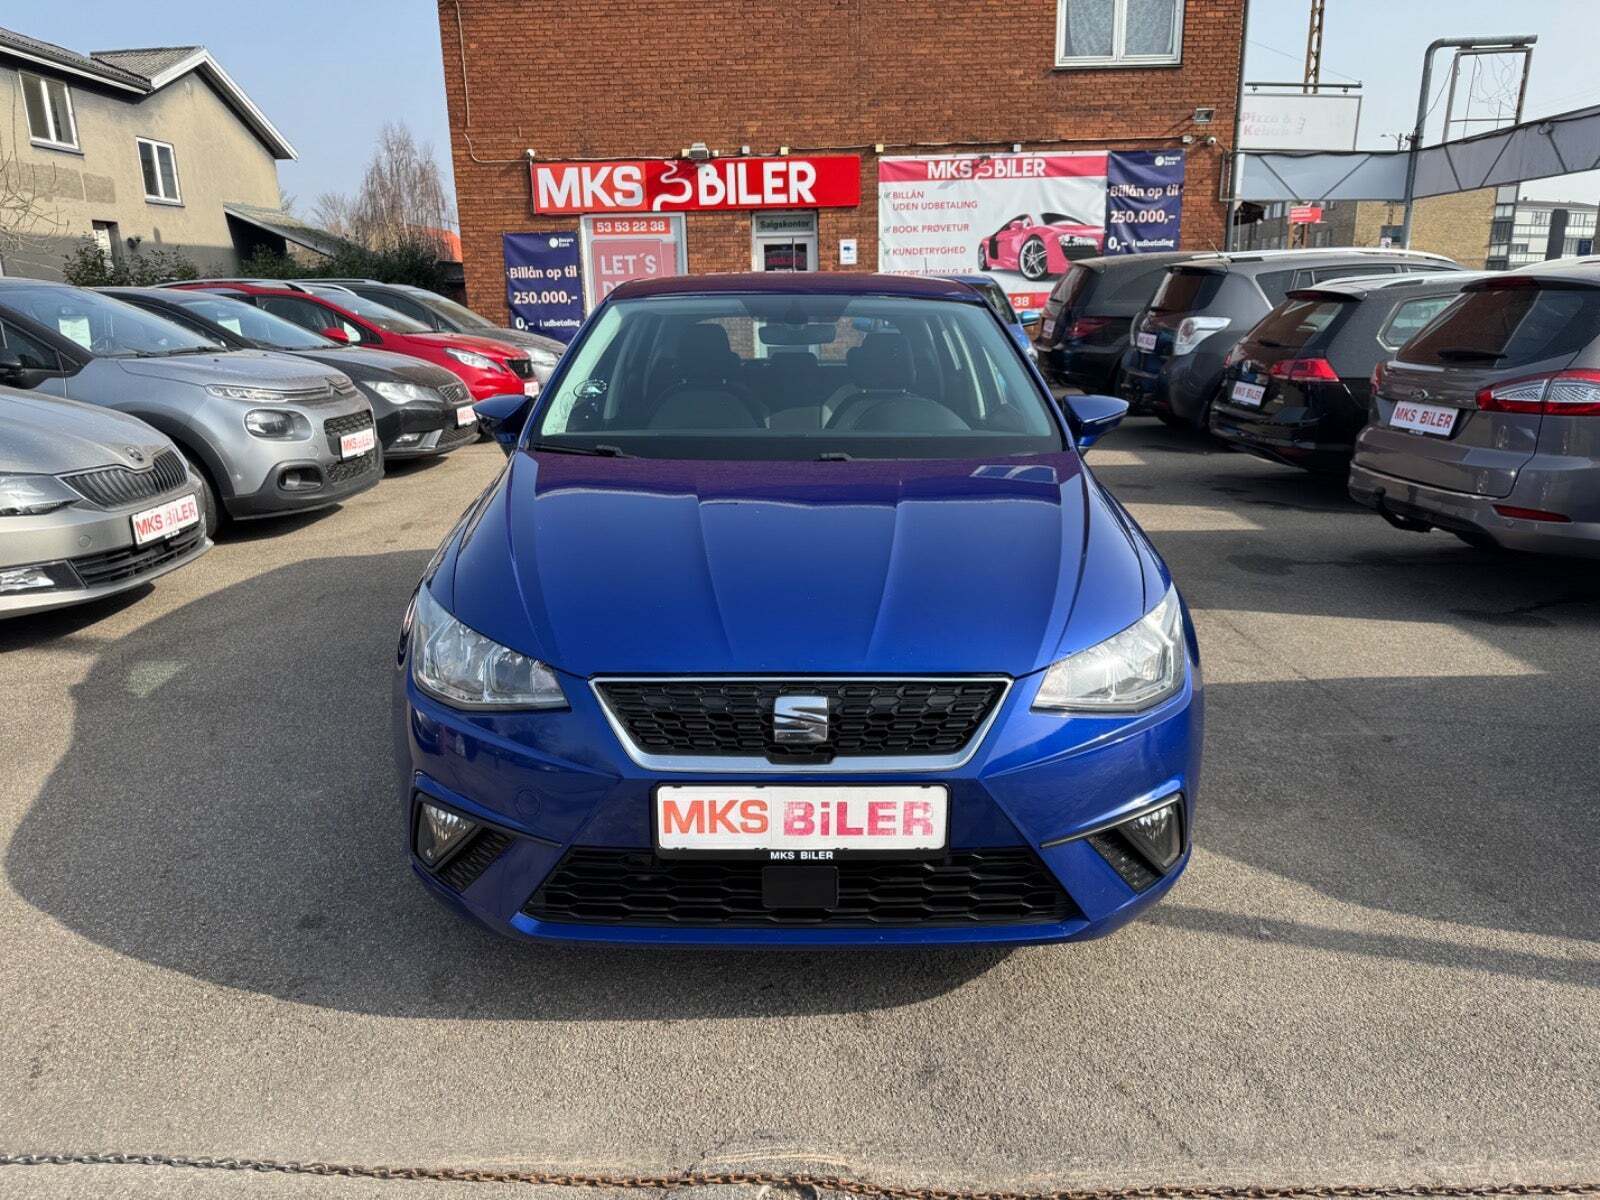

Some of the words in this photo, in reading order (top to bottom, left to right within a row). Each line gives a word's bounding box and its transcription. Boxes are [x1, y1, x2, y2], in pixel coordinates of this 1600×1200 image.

[928, 161, 973, 179] MKS
[994, 159, 1046, 178] BILER
[537, 166, 643, 208] MKS
[698, 161, 817, 206] BILER
[1110, 184, 1144, 197] Billån
[1147, 187, 1163, 200] op
[1166, 184, 1179, 196] til
[892, 190, 924, 200] BILLÅN
[893, 203, 919, 211] UDEN
[921, 201, 977, 211] UDBETALING
[1110, 210, 1176, 224] 250.000,-
[596, 222, 611, 232] 53
[614, 222, 629, 232] 53
[632, 221, 647, 232] 22
[650, 221, 665, 232] 38
[892, 225, 919, 233] BOOK
[892, 246, 967, 256] KUNDETRYGHED
[510, 266, 543, 279] Billån
[546, 268, 561, 281] op
[564, 265, 577, 278] til
[513, 290, 578, 305] 250.000,-
[1394, 407, 1417, 422] MKS
[135, 513, 163, 537] MKS
[662, 799, 769, 834] MKS
[783, 801, 934, 836] BiLER
[770, 851, 795, 860] MKS
